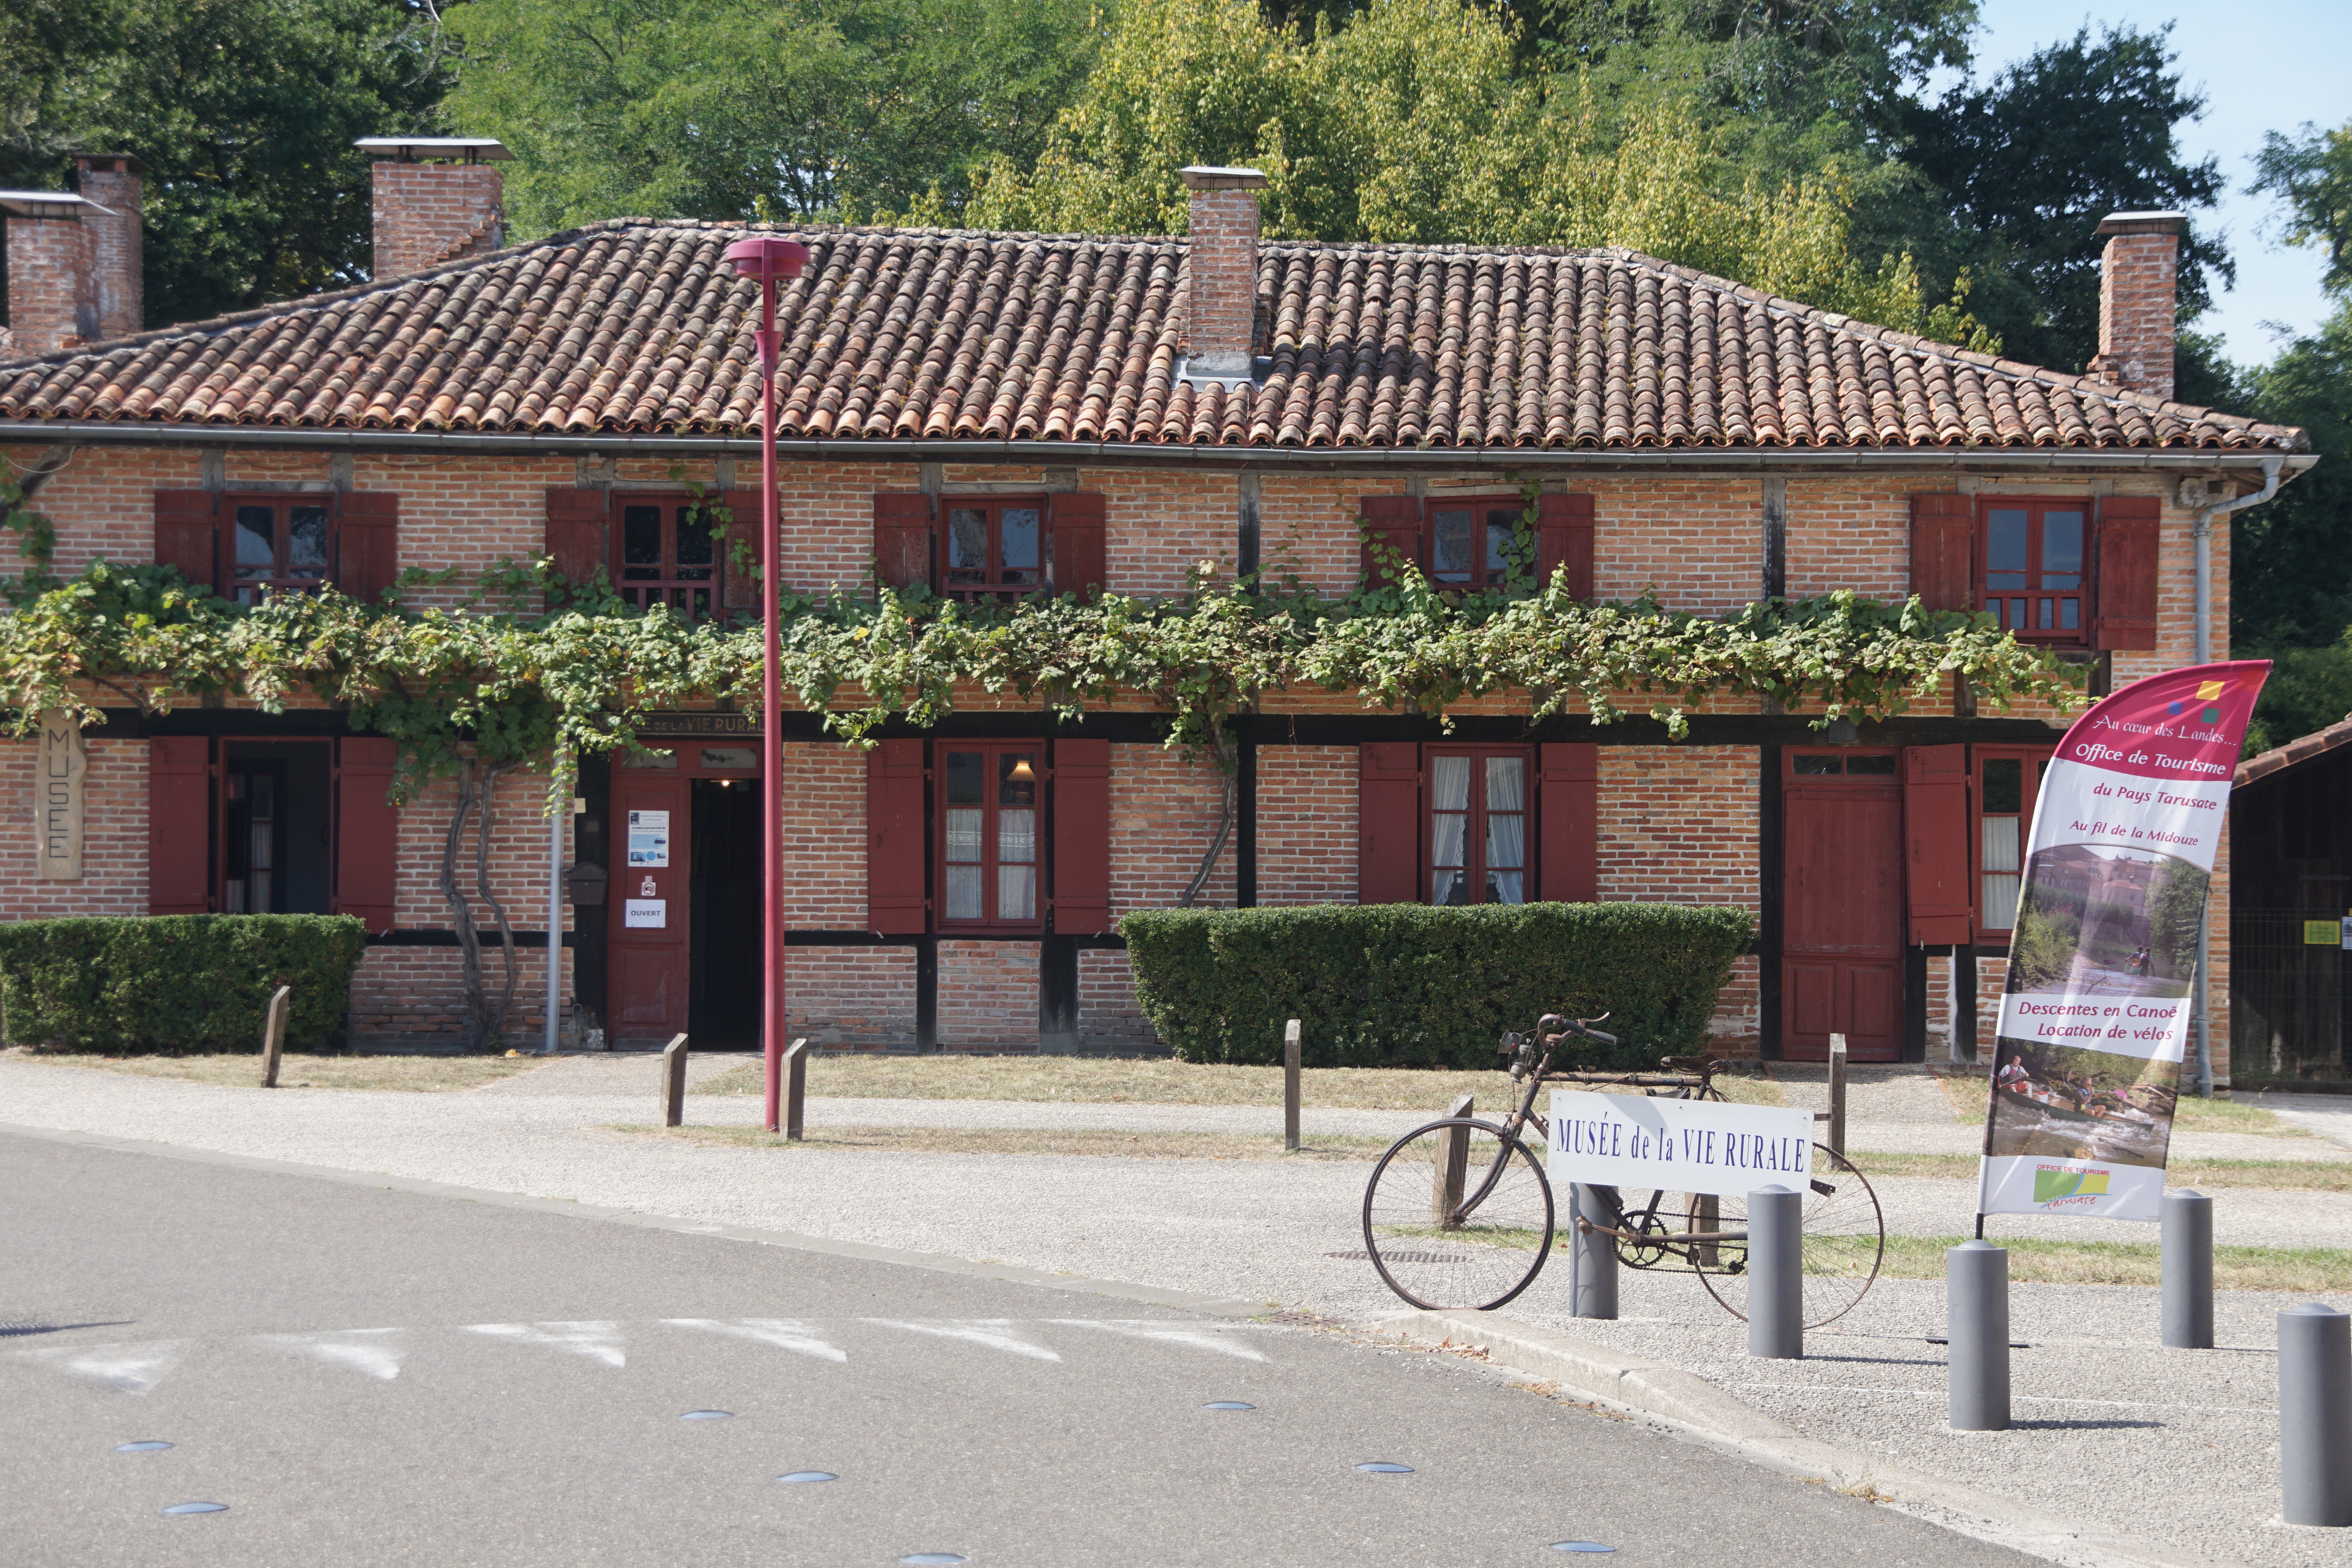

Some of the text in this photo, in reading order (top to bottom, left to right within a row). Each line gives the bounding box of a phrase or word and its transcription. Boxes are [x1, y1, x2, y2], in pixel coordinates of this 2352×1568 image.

[655, 722, 670, 731] DE
[671, 722, 686, 731] LA
[686, 717, 711, 731] VIE
[714, 718, 766, 732] RURAL
[2092, 715, 2119, 730] Au
[2123, 722, 2152, 734] cœur
[2155, 722, 2174, 737] des
[2076, 743, 2226, 775] Office de Tourisme
[2093, 783, 2217, 810] du Pays Tarusate
[2069, 820, 2199, 846] Au fil de la Midouze
[2018, 1002, 2177, 1018] Descentes en Canoë
[2037, 1023, 2174, 1040] Location de vélos
[1556, 1111, 1805, 1172] MUSÉE de la VIE RURALE
